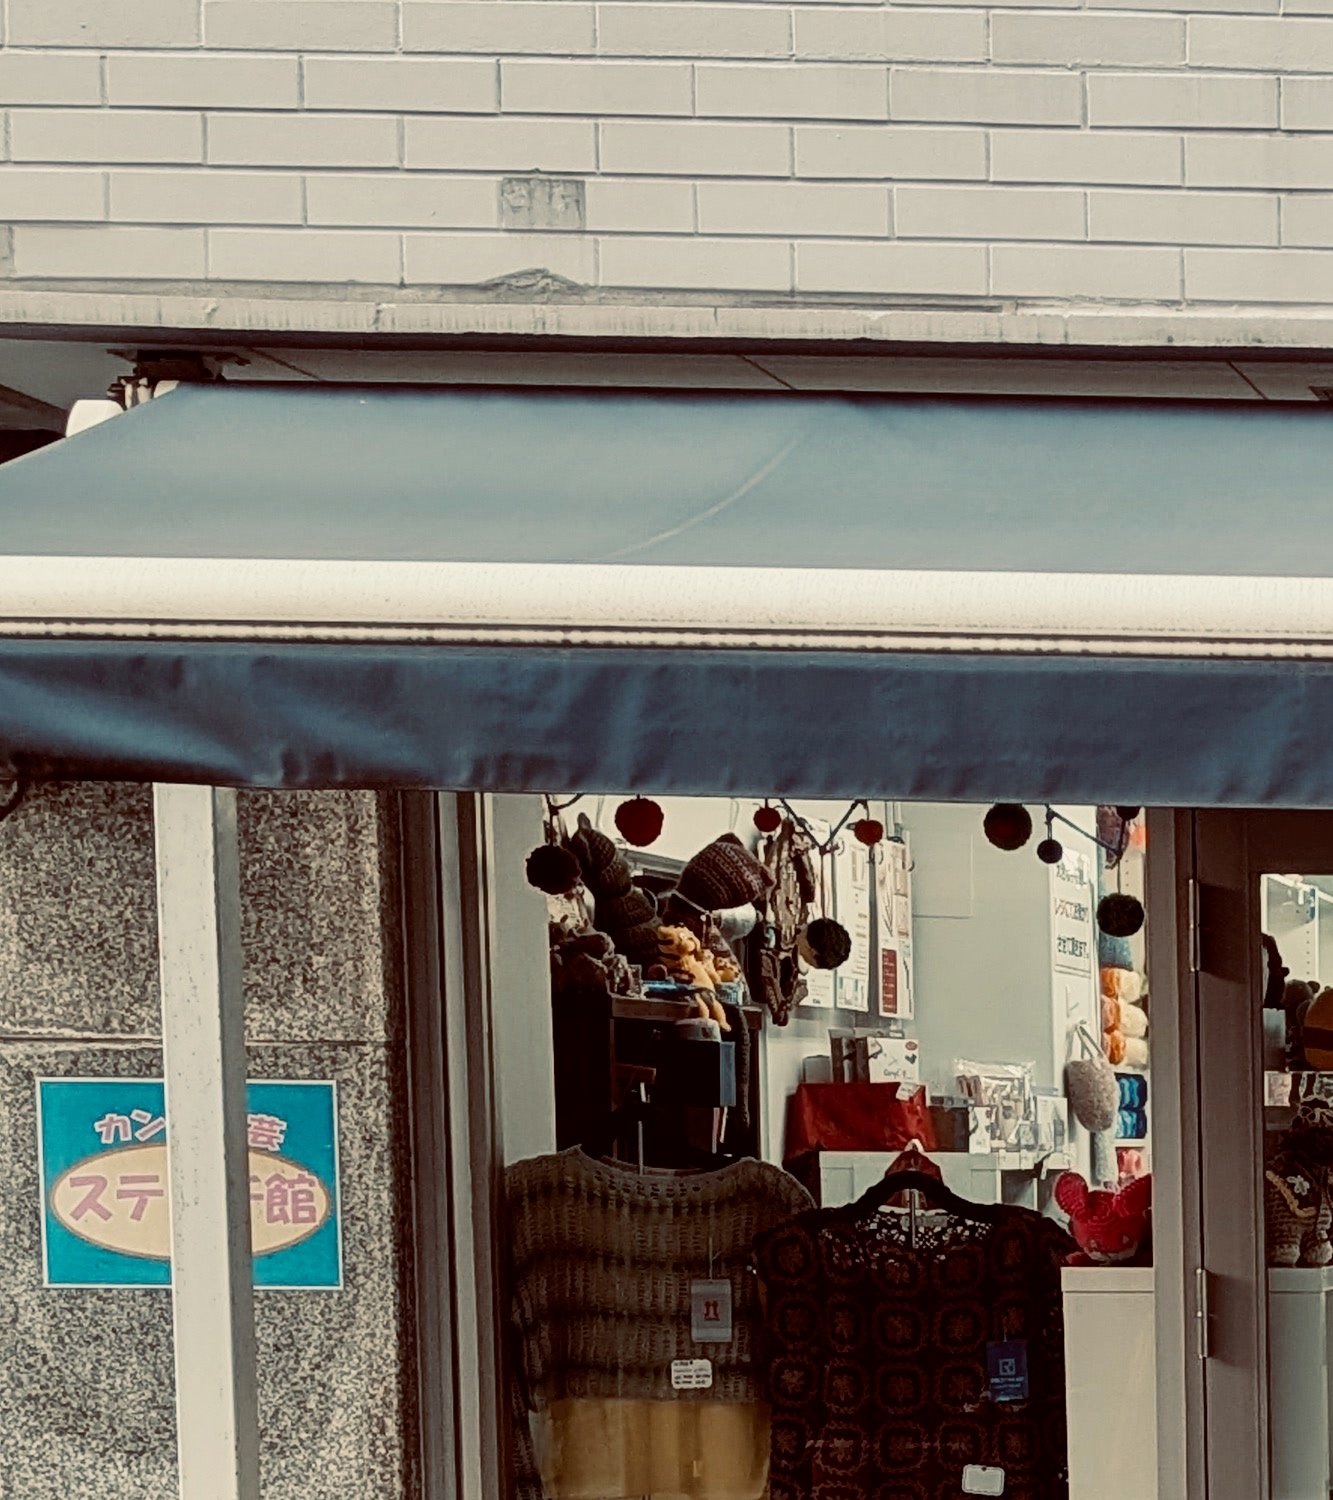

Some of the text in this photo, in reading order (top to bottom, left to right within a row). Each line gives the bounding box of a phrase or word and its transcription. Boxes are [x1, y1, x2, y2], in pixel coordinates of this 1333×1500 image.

[94, 1109, 287, 1151] カン芸
[69, 1172, 318, 1226] ステ館
